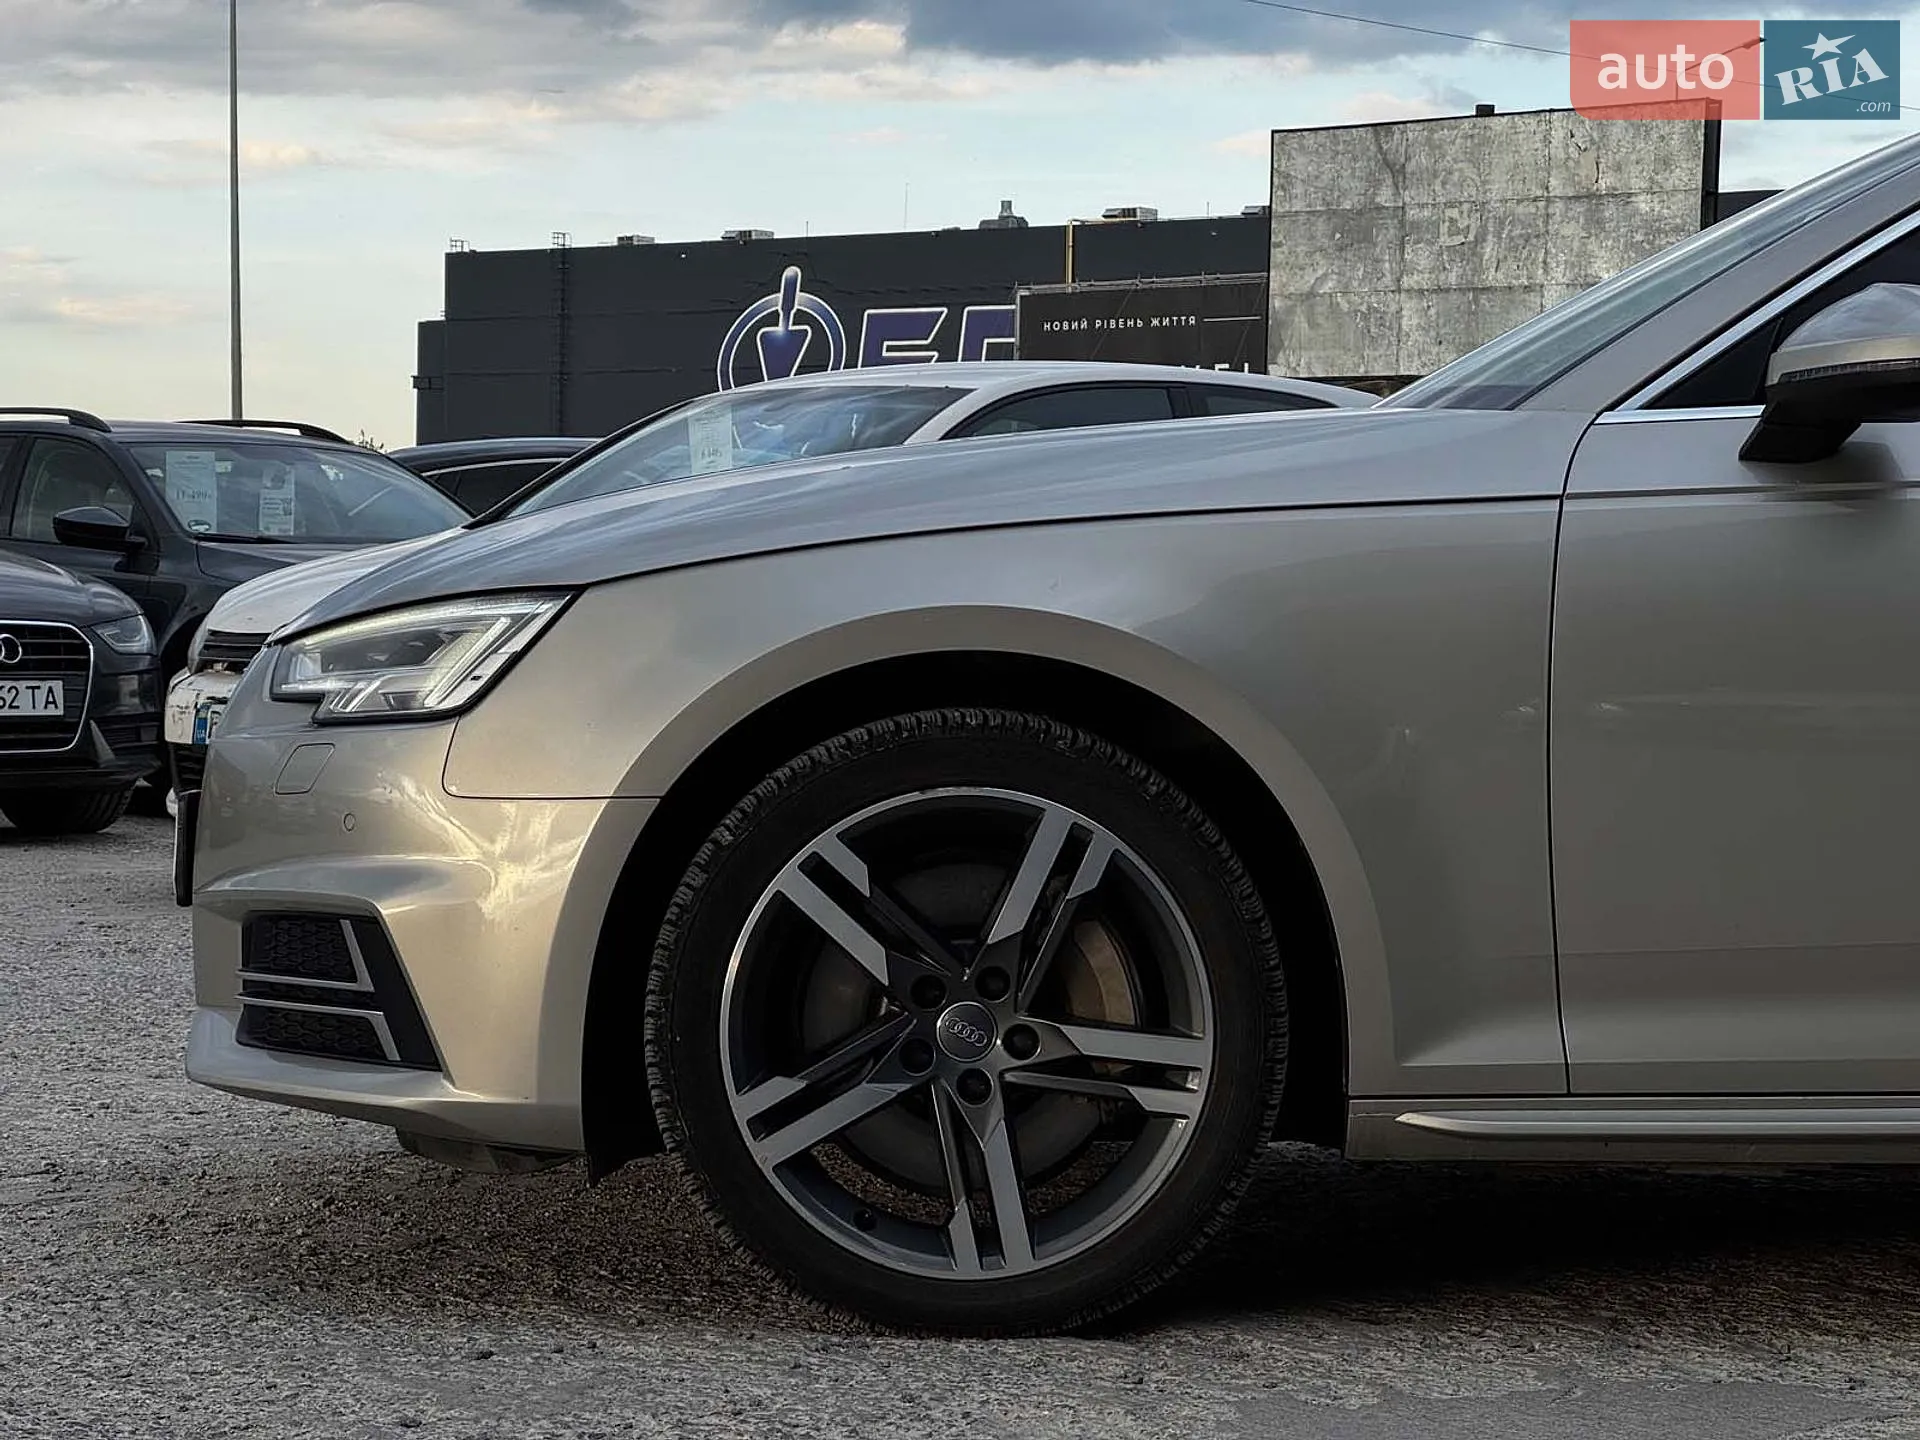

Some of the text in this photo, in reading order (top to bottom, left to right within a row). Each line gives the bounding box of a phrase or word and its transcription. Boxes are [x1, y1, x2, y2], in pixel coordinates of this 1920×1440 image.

[1043, 316, 1196, 331] НОВИЙ РІВЕНЬ ЖИТТЯ
[25, 685, 58, 710] TA
